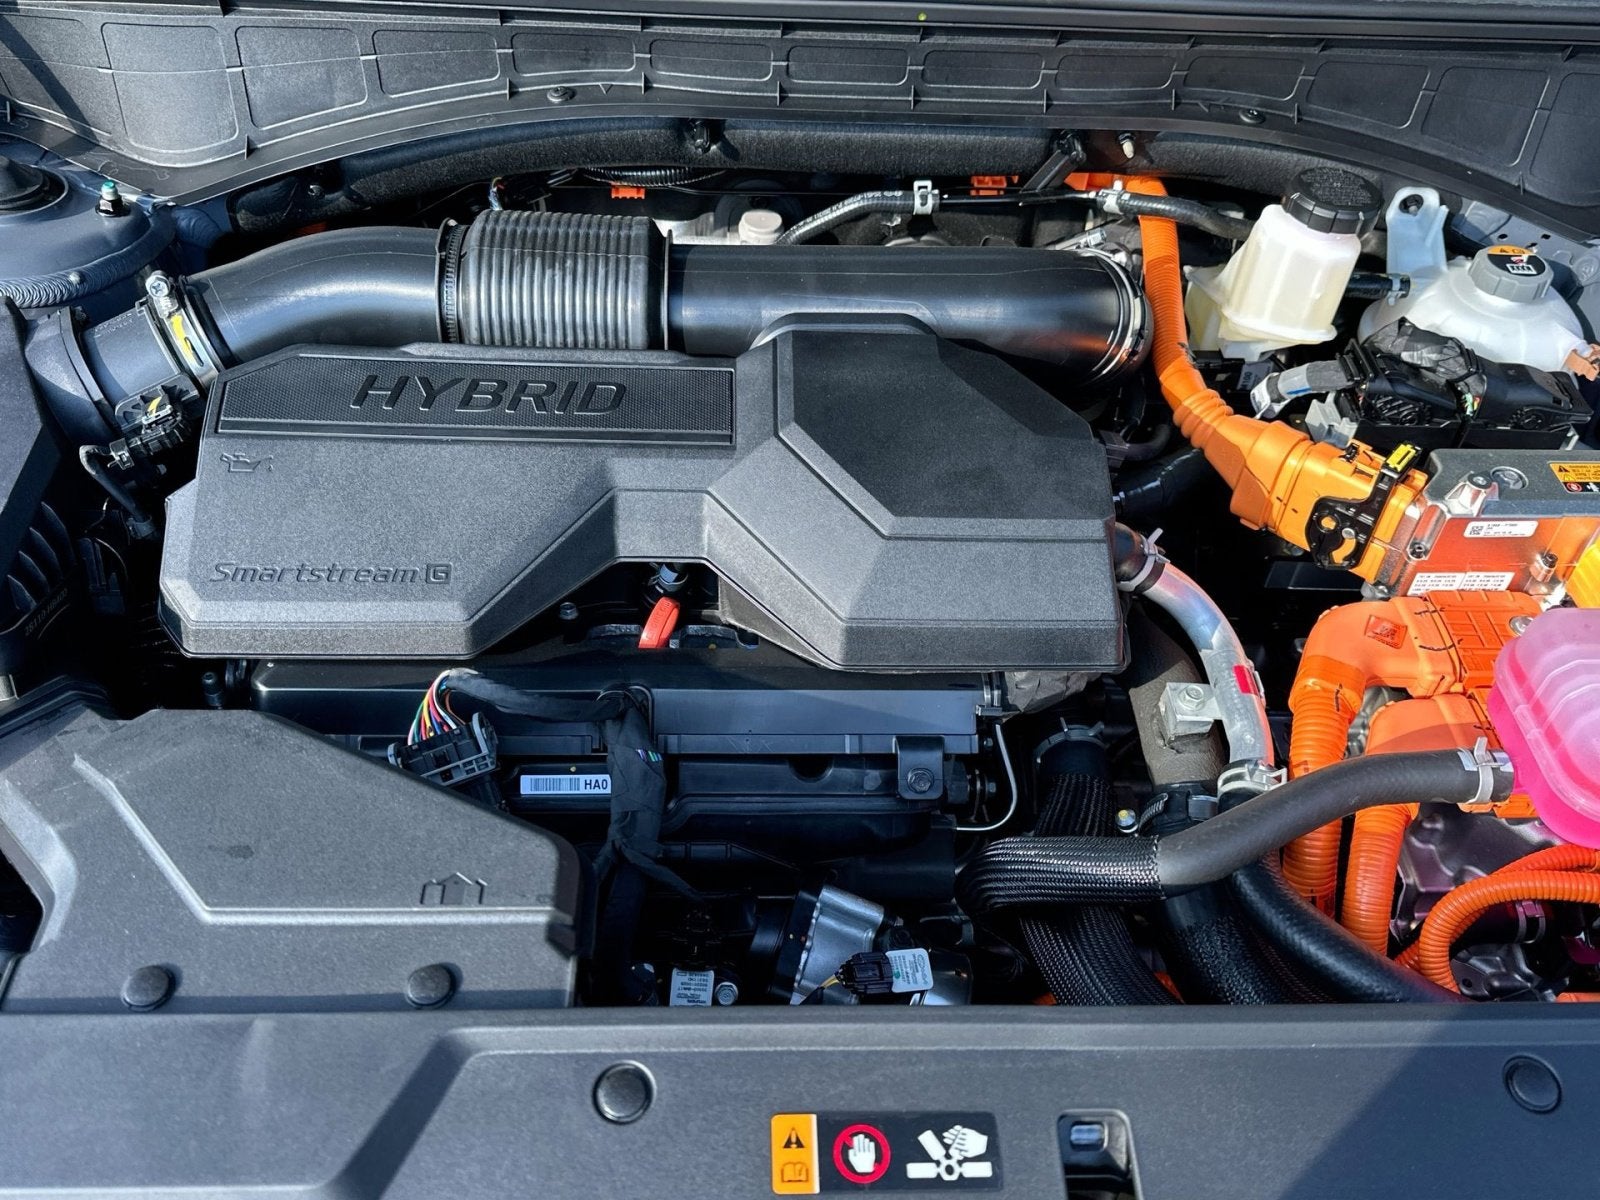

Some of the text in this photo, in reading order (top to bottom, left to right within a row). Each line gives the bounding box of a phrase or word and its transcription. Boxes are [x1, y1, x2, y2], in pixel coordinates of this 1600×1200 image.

[350, 374, 627, 415] HYBRID
[209, 562, 451, 584] Smartstream G
